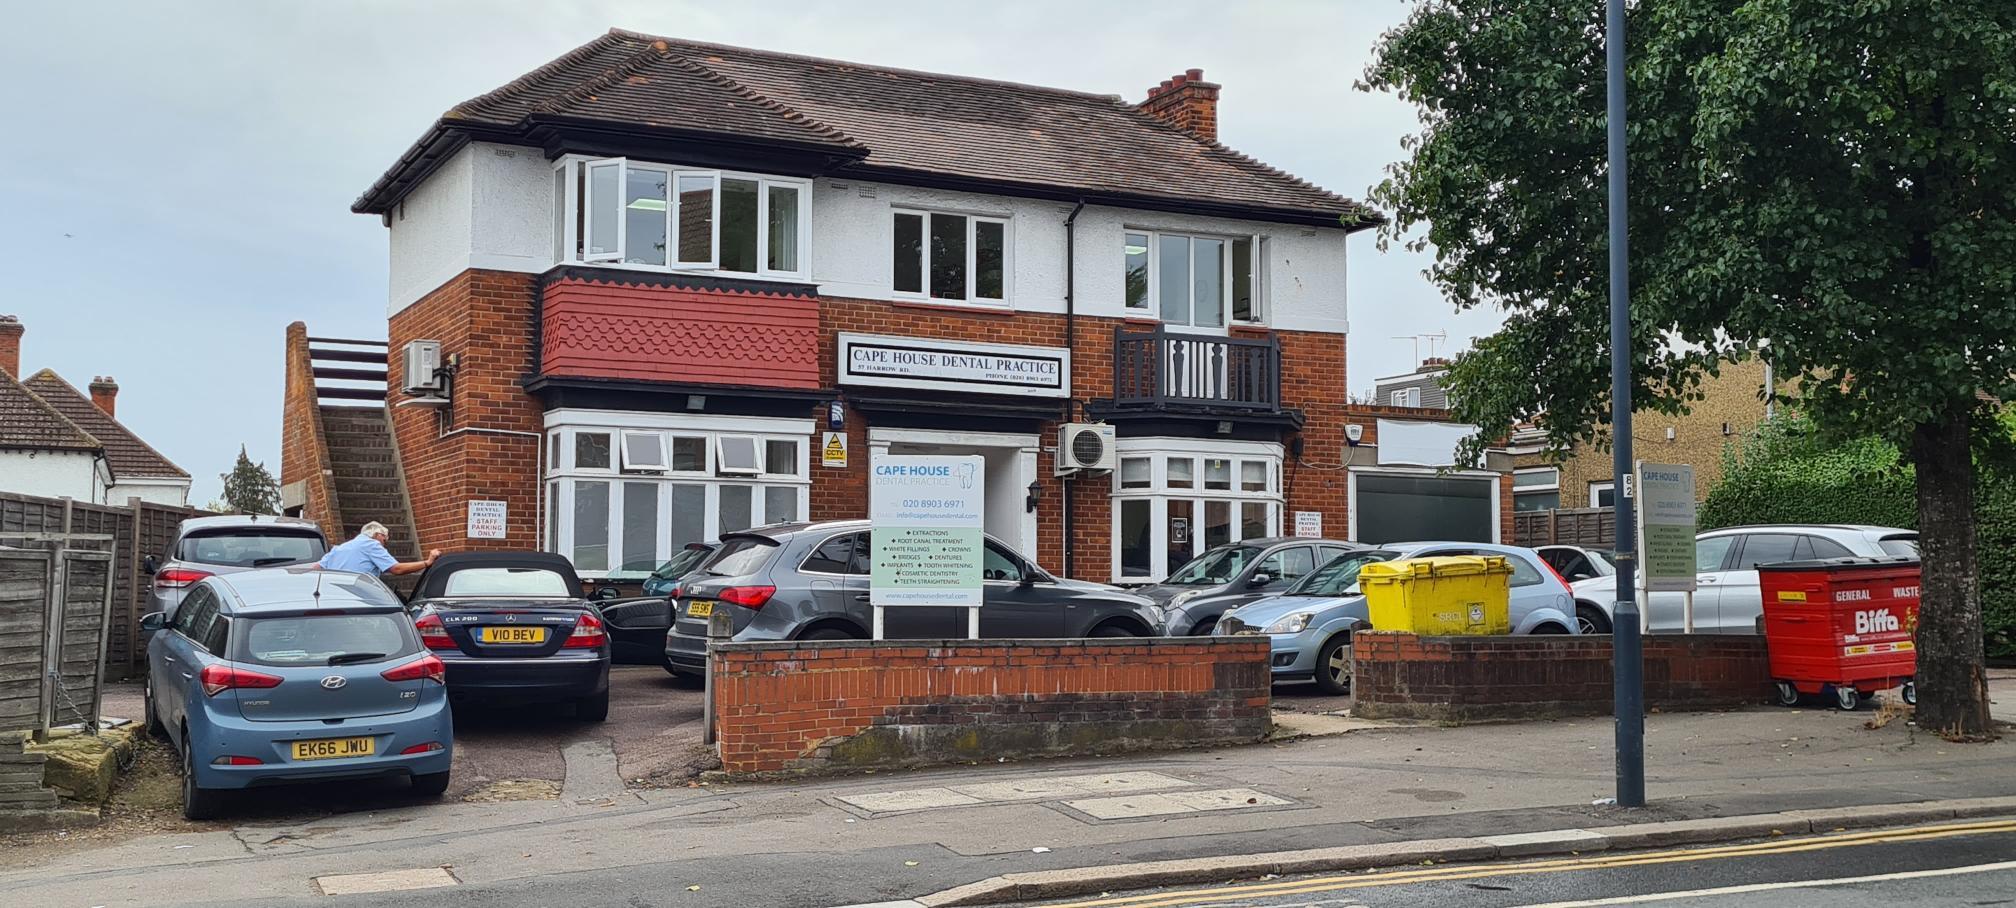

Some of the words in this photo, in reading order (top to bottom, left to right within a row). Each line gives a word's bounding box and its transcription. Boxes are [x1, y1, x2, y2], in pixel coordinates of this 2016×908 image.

[854, 349, 887, 363] CAPE
[893, 351, 937, 366] HOUSE
[942, 355, 992, 370] DENTAL
[997, 359, 1057, 374] PRACTICE
[876, 465, 906, 476] CAPE
[909, 466, 950, 476] HOUSE
[875, 477, 908, 486] DENTAL
[910, 477, 950, 487] PRACTICE
[1626, 475, 1632, 485] 8
[1643, 471, 1658, 481] CAPE
[1659, 472, 1679, 482] HOUSE
[1626, 487, 1632, 495] 2
[902, 499, 919, 508] 020
[921, 499, 942, 508] 8903
[944, 499, 964, 508] 6971
[885, 592, 968, 600] www.capehousedental.com
[1836, 589, 1871, 602] GENERAL
[1893, 586, 1919, 598] WASTE
[1855, 607, 1899, 634] Biffa
[492, 629, 510, 641] V10
[513, 629, 535, 641] BEV
[298, 742, 337, 757] EK66
[340, 740, 368, 754] JWU
